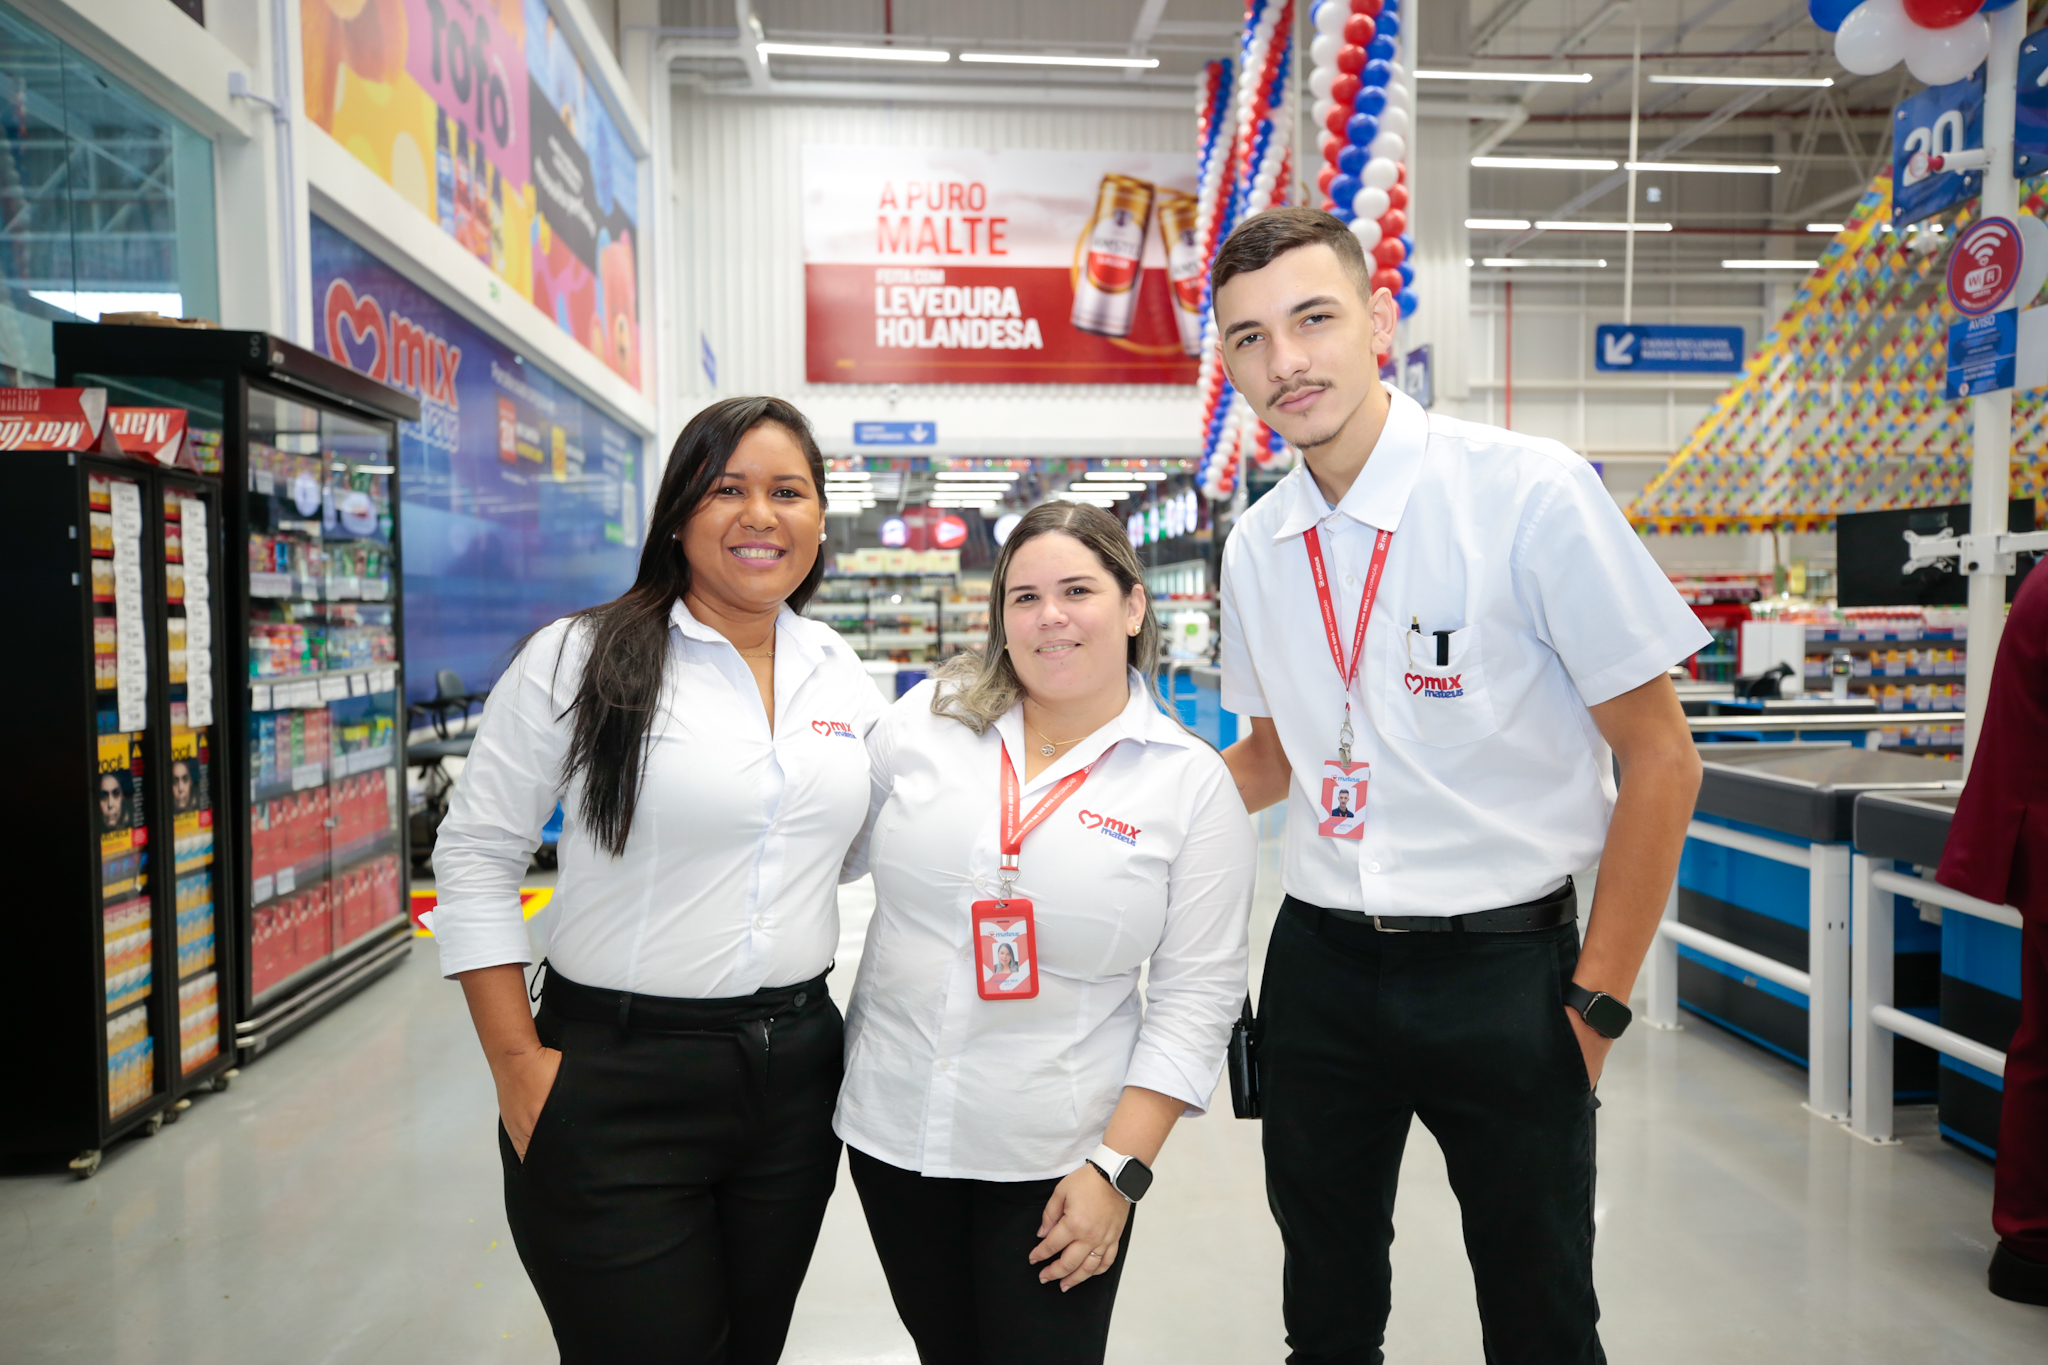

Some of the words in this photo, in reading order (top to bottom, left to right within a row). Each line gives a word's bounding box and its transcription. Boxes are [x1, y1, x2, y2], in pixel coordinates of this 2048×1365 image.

[1903, 110, 1963, 187] 20
[879, 181, 898, 210] A
[907, 182, 986, 211] PURO
[878, 216, 1008, 255] MALTE
[876, 286, 1021, 317] LEVEDURA
[876, 317, 1043, 349] HOLANDESA
[1968, 315, 1996, 331] AVISO
[390, 311, 461, 412] mix
[1369, 563, 1378, 589] CORAÇÃO
[1367, 589, 1372, 598] NO
[1324, 599, 1332, 623] CORAÇÃO
[1359, 623, 1364, 631] DE
[1425, 674, 1462, 690] mix
[1425, 689, 1463, 698] mateus
[1032, 811, 1039, 820] DE
[1037, 805, 1046, 815] SER
[1044, 798, 1055, 808] ESTÁ
[1058, 778, 1076, 796] CORAÇÃO
[1101, 827, 1136, 847] mateus
[1104, 817, 1142, 840] mix
